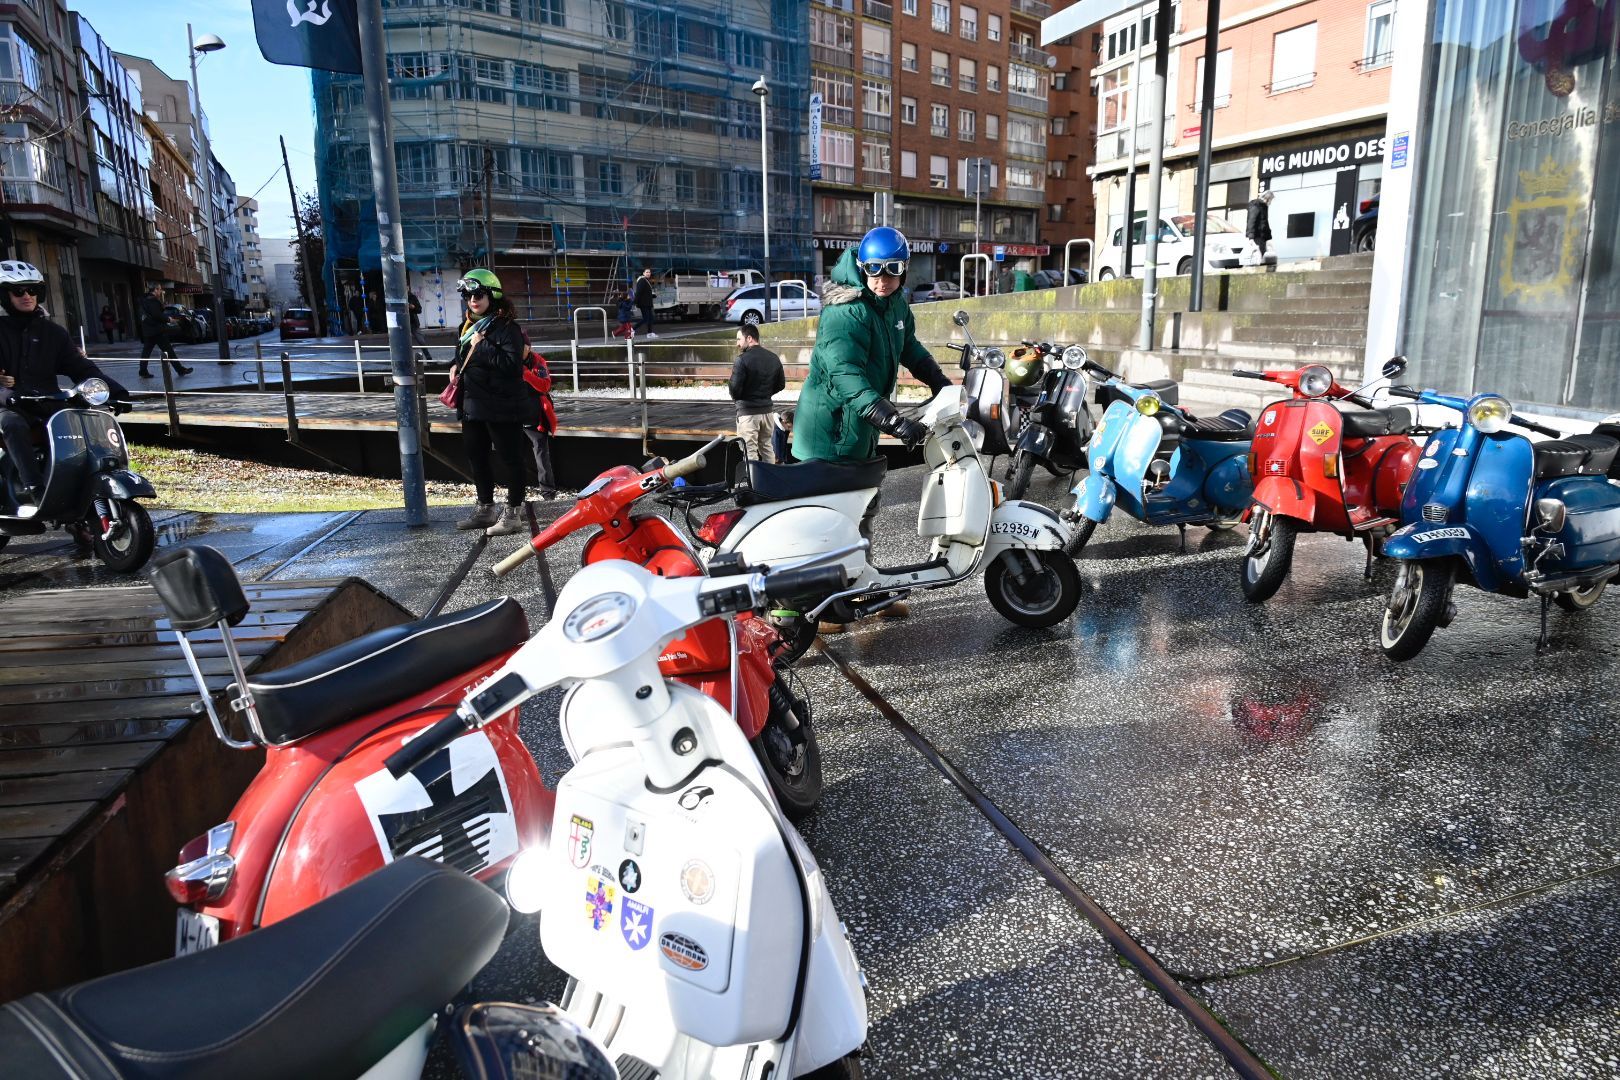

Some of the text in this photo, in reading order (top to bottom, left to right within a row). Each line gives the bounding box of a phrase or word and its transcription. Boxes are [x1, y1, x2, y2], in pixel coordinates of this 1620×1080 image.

[1508, 106, 1596, 140] Concejalía
[1262, 155, 1285, 174] MG
[1288, 144, 1350, 170] MUNDO
[991, 522, 1040, 538] LE-2939-N
